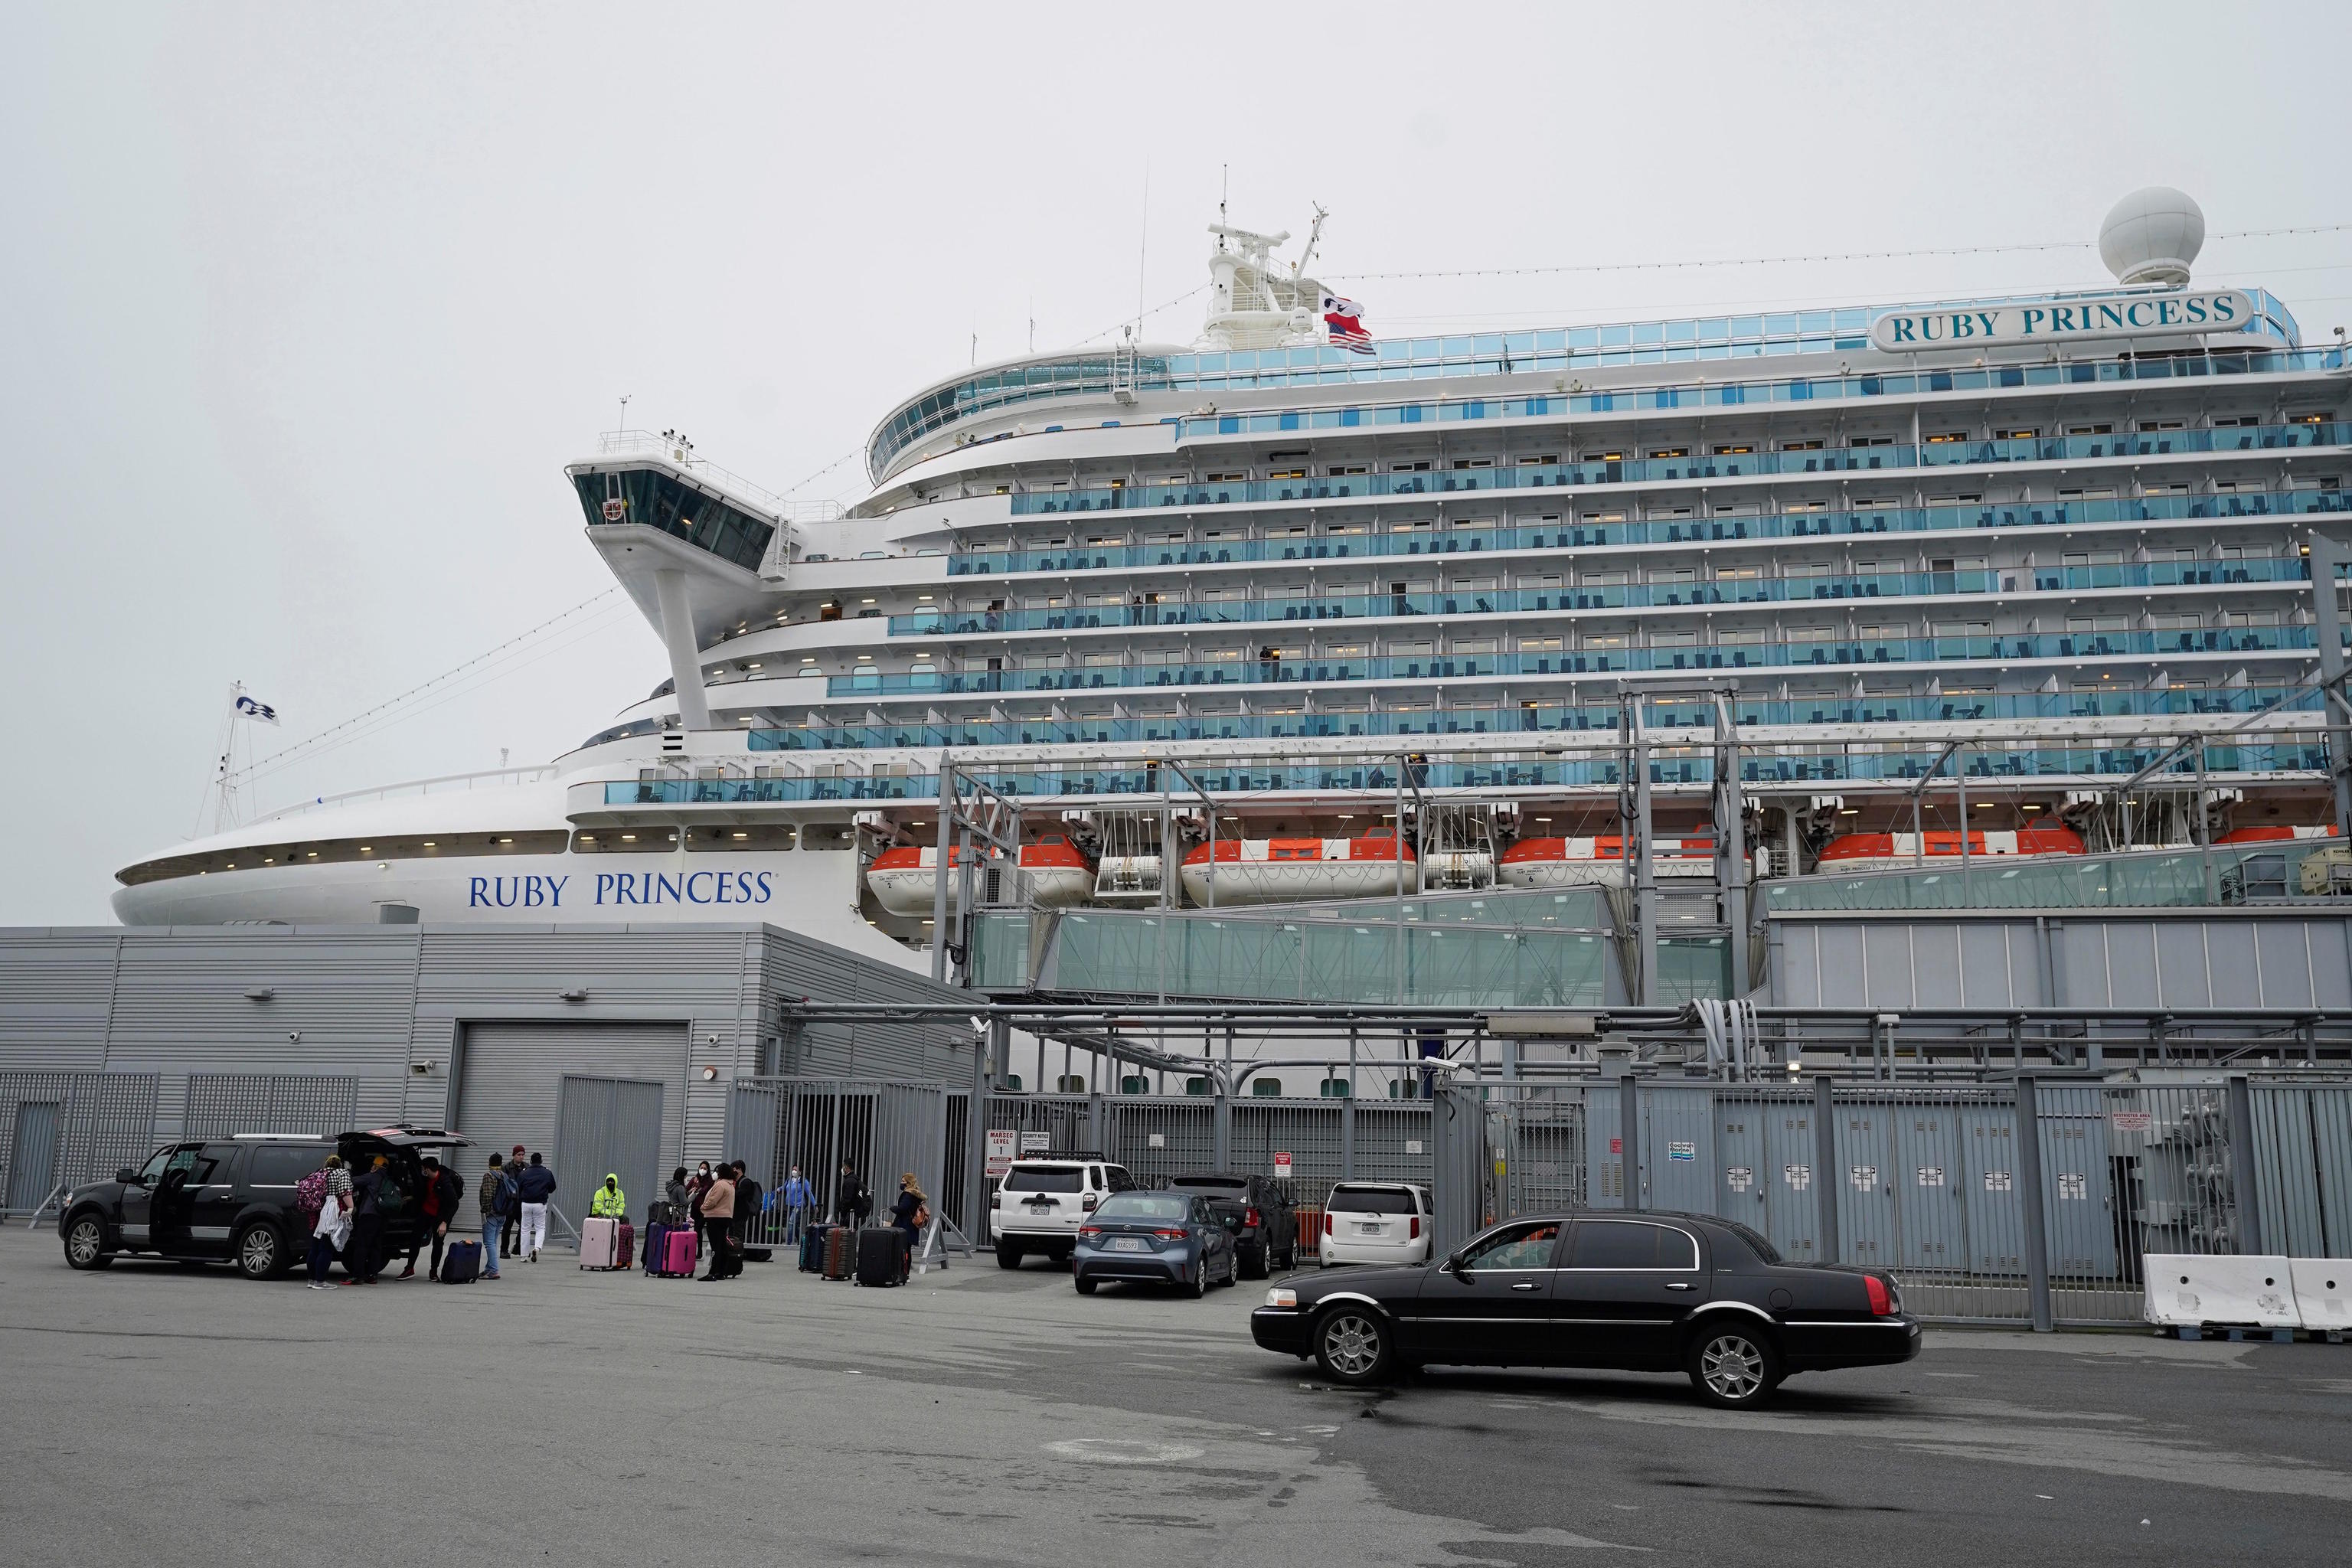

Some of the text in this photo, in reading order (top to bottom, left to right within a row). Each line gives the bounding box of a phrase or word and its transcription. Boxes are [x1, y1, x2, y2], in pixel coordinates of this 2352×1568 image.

[1891, 296, 2236, 342] RUBY PRINCESS
[468, 871, 772, 907] RUBY PRINCESS
[1000, 1146, 1002, 1155] 1
